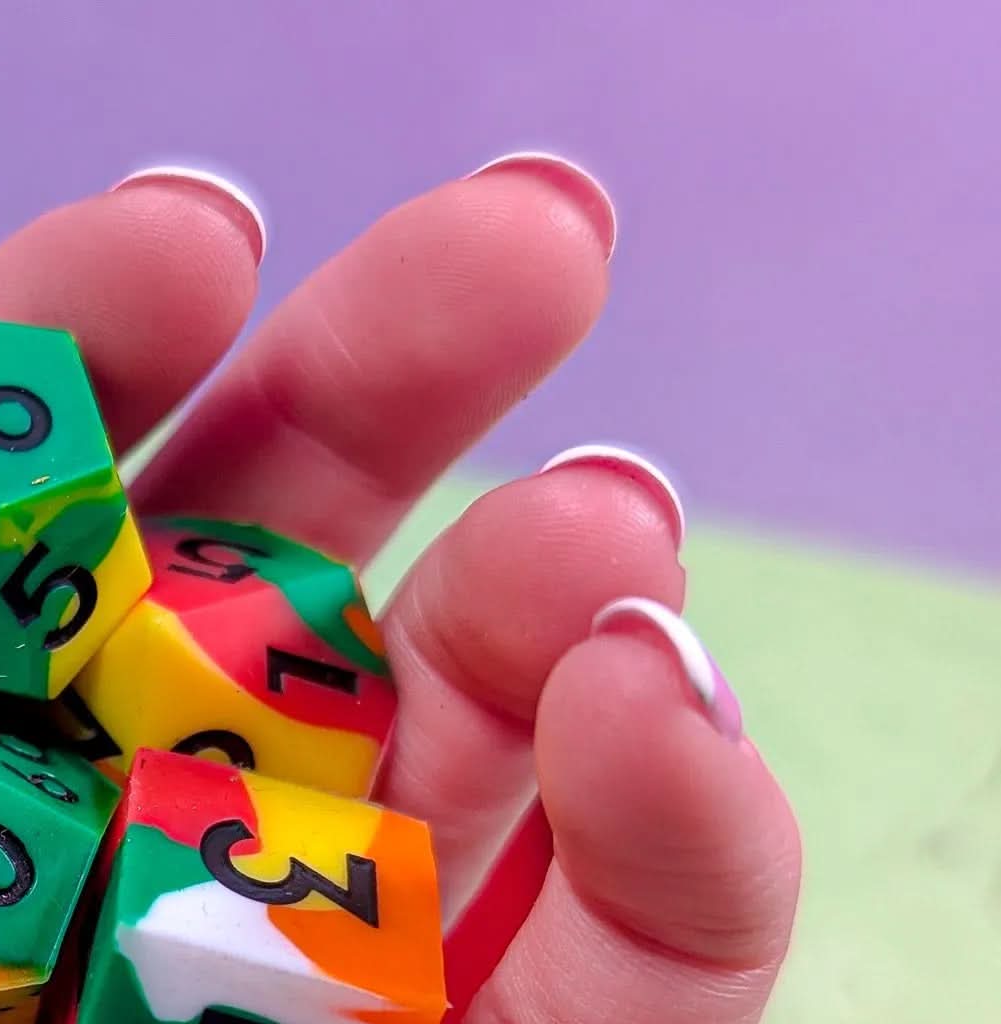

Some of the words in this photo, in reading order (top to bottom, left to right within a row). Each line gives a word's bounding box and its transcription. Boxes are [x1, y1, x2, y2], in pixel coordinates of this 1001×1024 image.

[0, 541, 99, 650] 5
[167, 538, 272, 584] 5
[200, 819, 380, 929] 3
